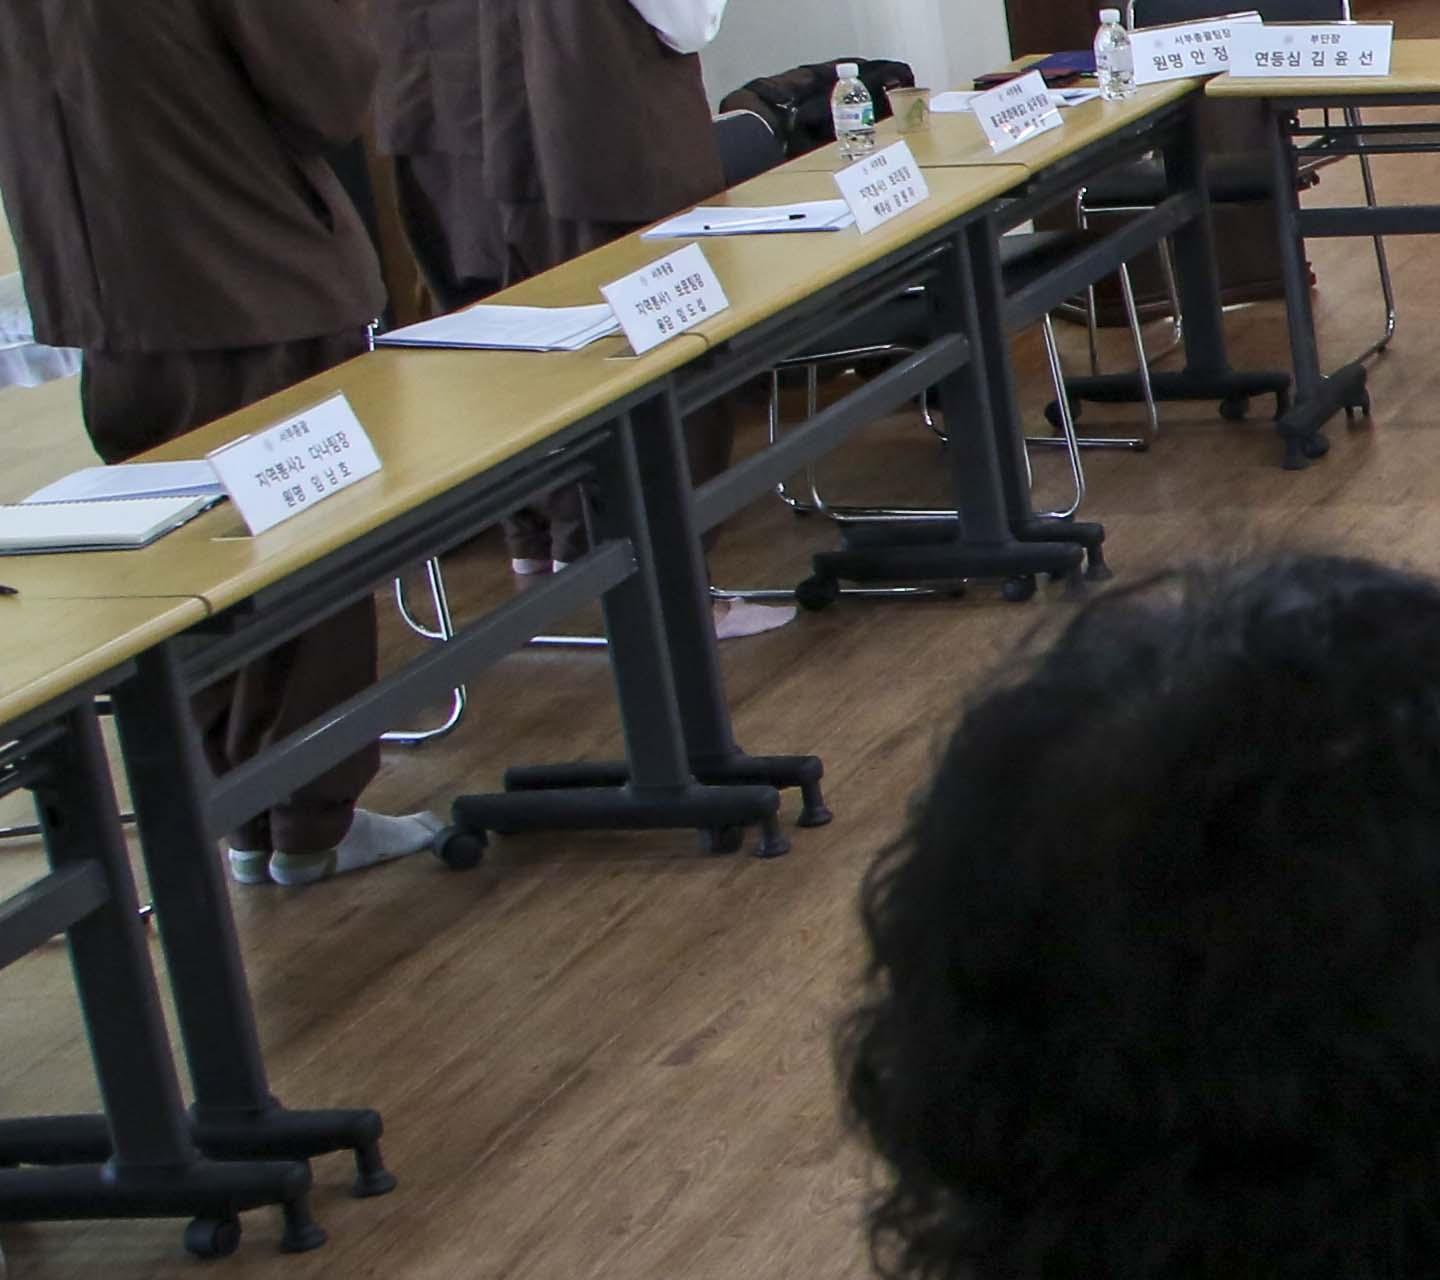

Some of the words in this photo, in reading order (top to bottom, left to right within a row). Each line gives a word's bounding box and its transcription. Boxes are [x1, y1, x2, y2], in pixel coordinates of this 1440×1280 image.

[1255, 51, 1301, 67] 연등심
[254, 455, 305, 488] 지역봉사2
[308, 430, 350, 462] 다나팀장
